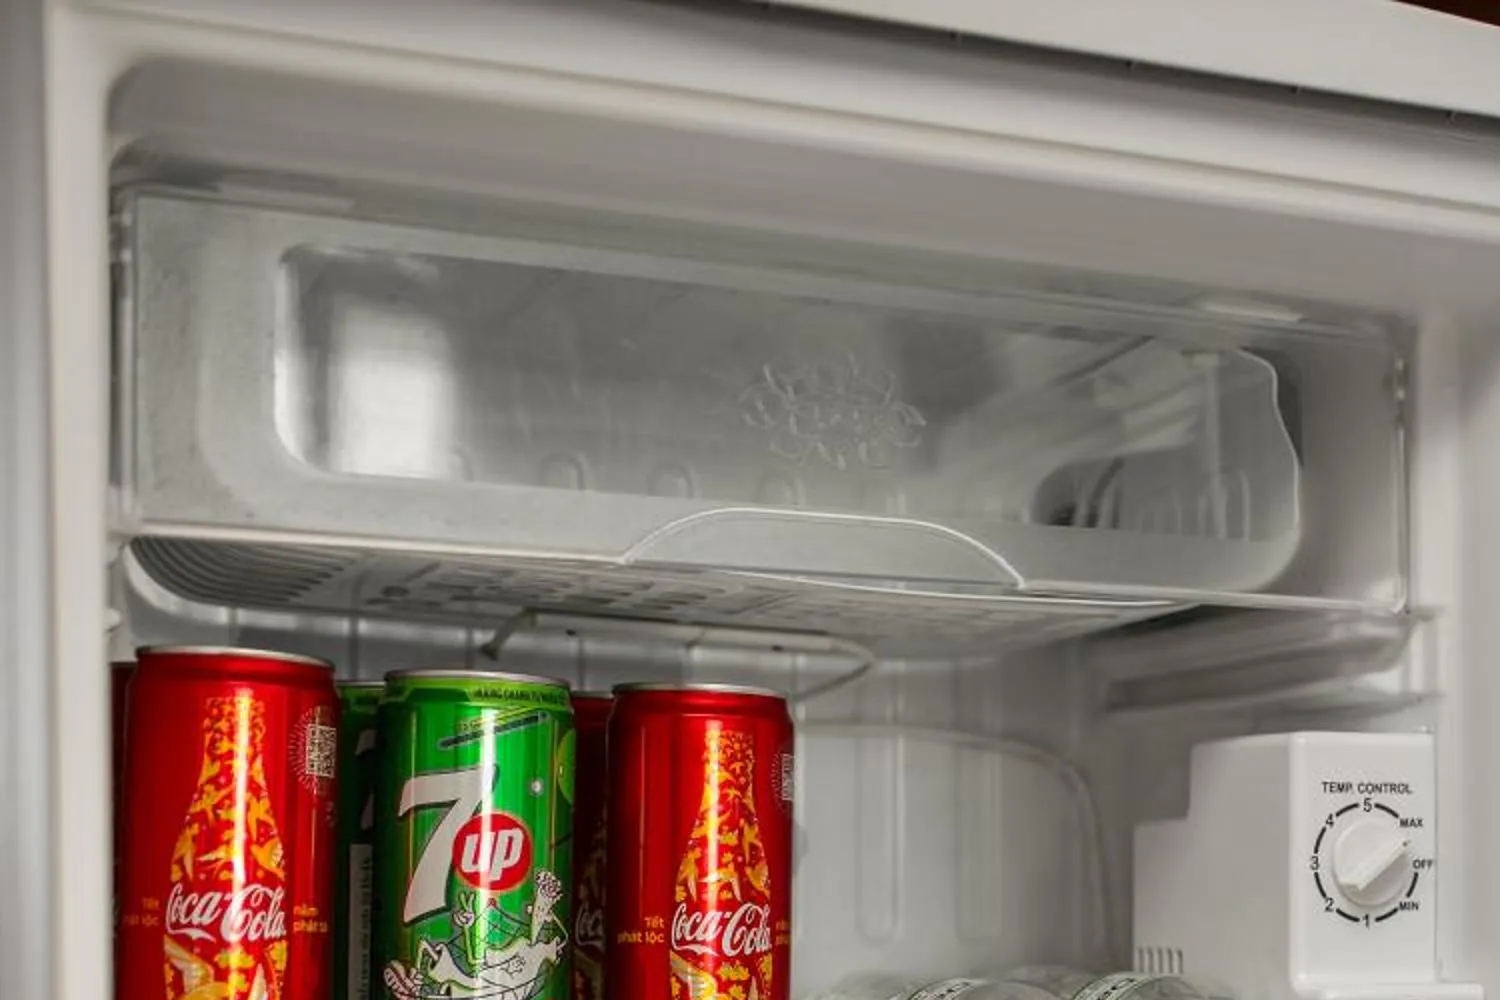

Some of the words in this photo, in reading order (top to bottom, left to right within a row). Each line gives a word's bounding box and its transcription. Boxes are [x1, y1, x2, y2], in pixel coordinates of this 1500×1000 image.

[1357, 782, 1413, 795] CONTROL
[1363, 797, 1373, 813] 5
[1325, 813, 1335, 828] 4
[1400, 818, 1424, 828] MAX
[1310, 855, 1320, 871] 3
[1412, 859, 1433, 869] OFF
[1325, 897, 1335, 913] 2
[1399, 901, 1420, 911] MIN
[165, 883, 287, 943] Coca-Cola
[671, 903, 772, 958] Coca-Cola
